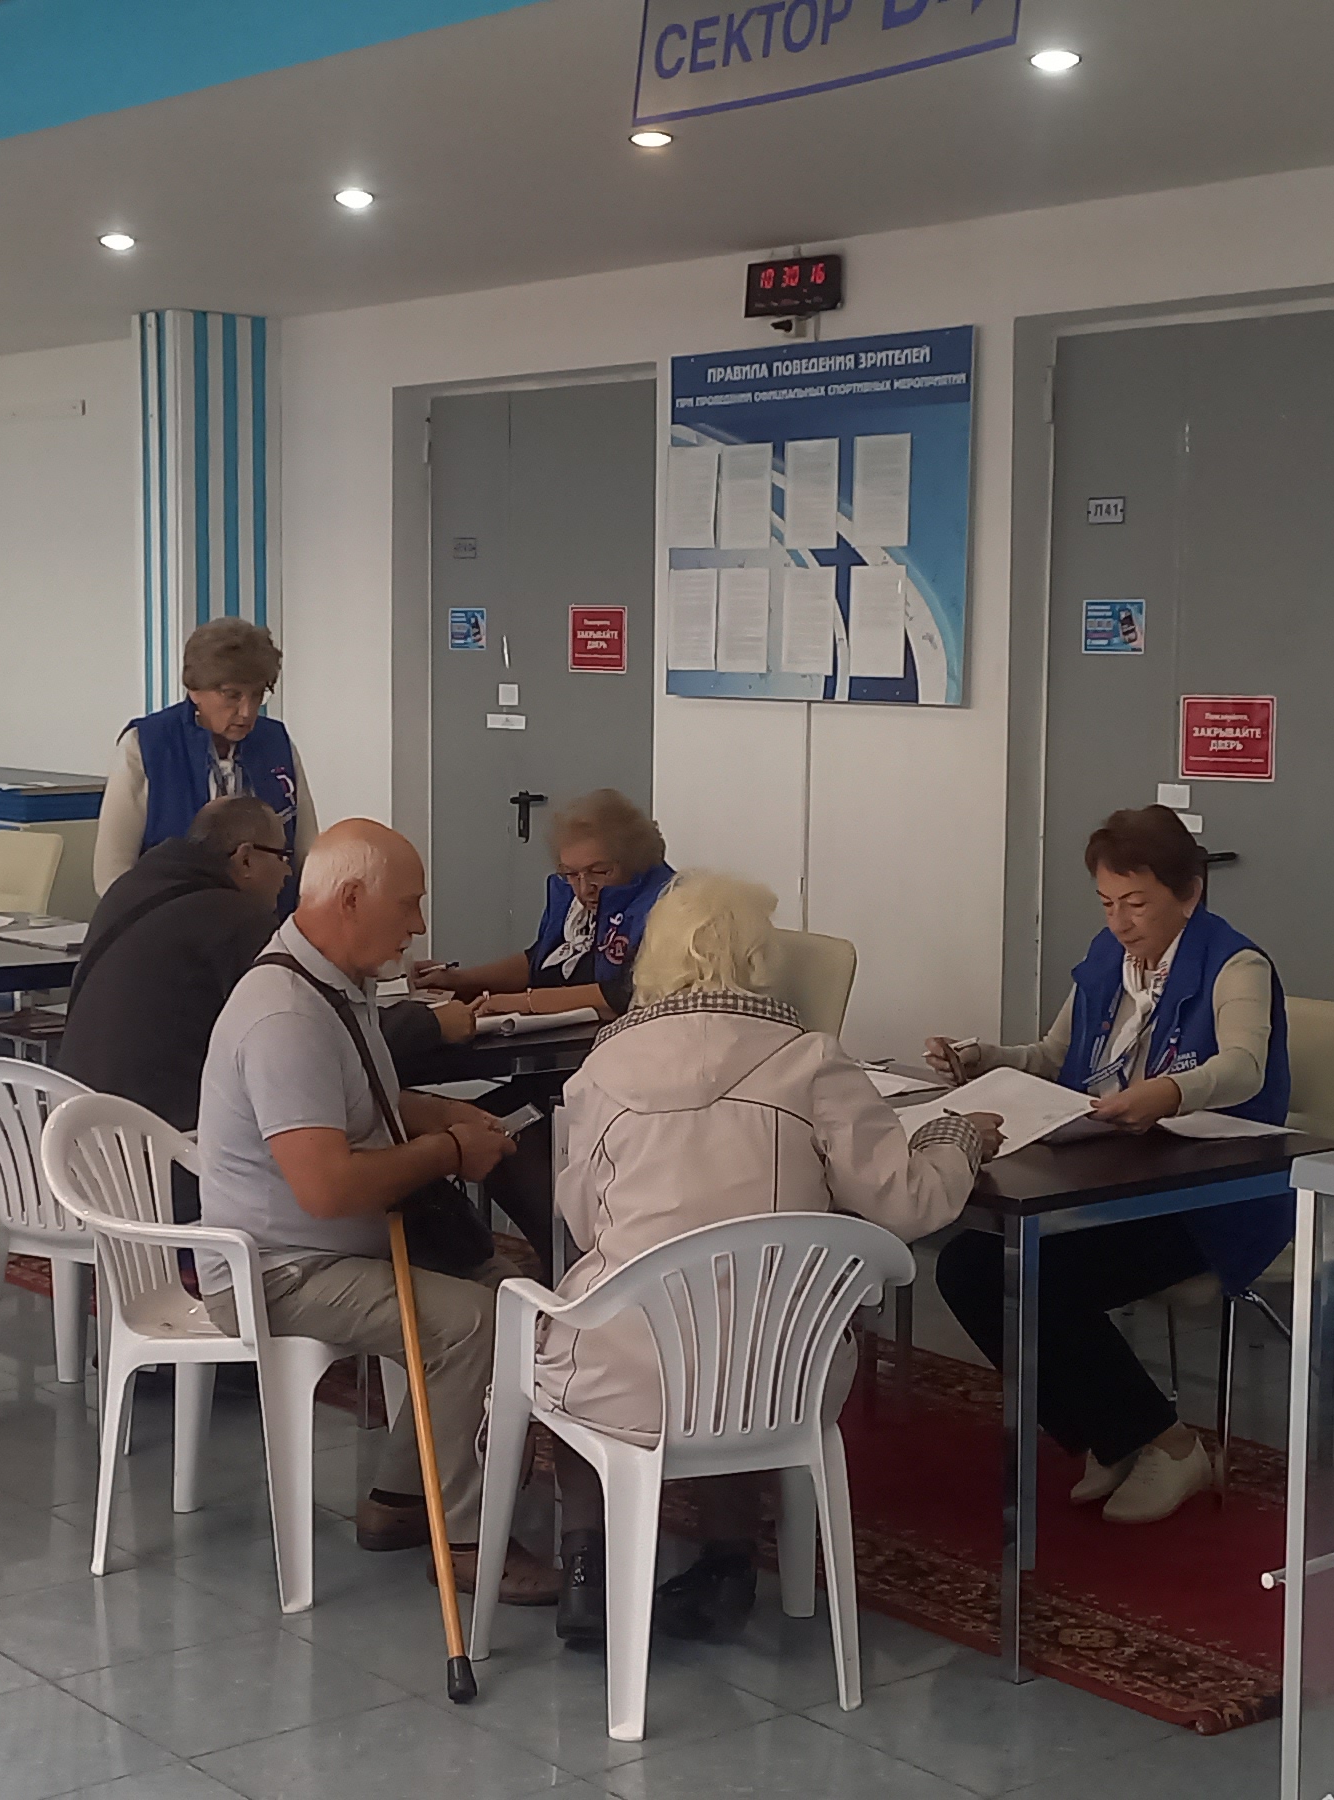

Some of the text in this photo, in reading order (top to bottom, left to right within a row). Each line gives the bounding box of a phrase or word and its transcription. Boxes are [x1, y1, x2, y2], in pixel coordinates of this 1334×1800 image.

[654, 0, 851, 80] СЕКТОР
[707, 346, 931, 383] ПРАВИЛА ПОВЕДЕНИЯ ЗРИТЕЛЕЙ
[1193, 726, 1262, 739] ЗАКРЫВАЙТЕ
[1209, 740, 1244, 752] ДВЕРЬ
